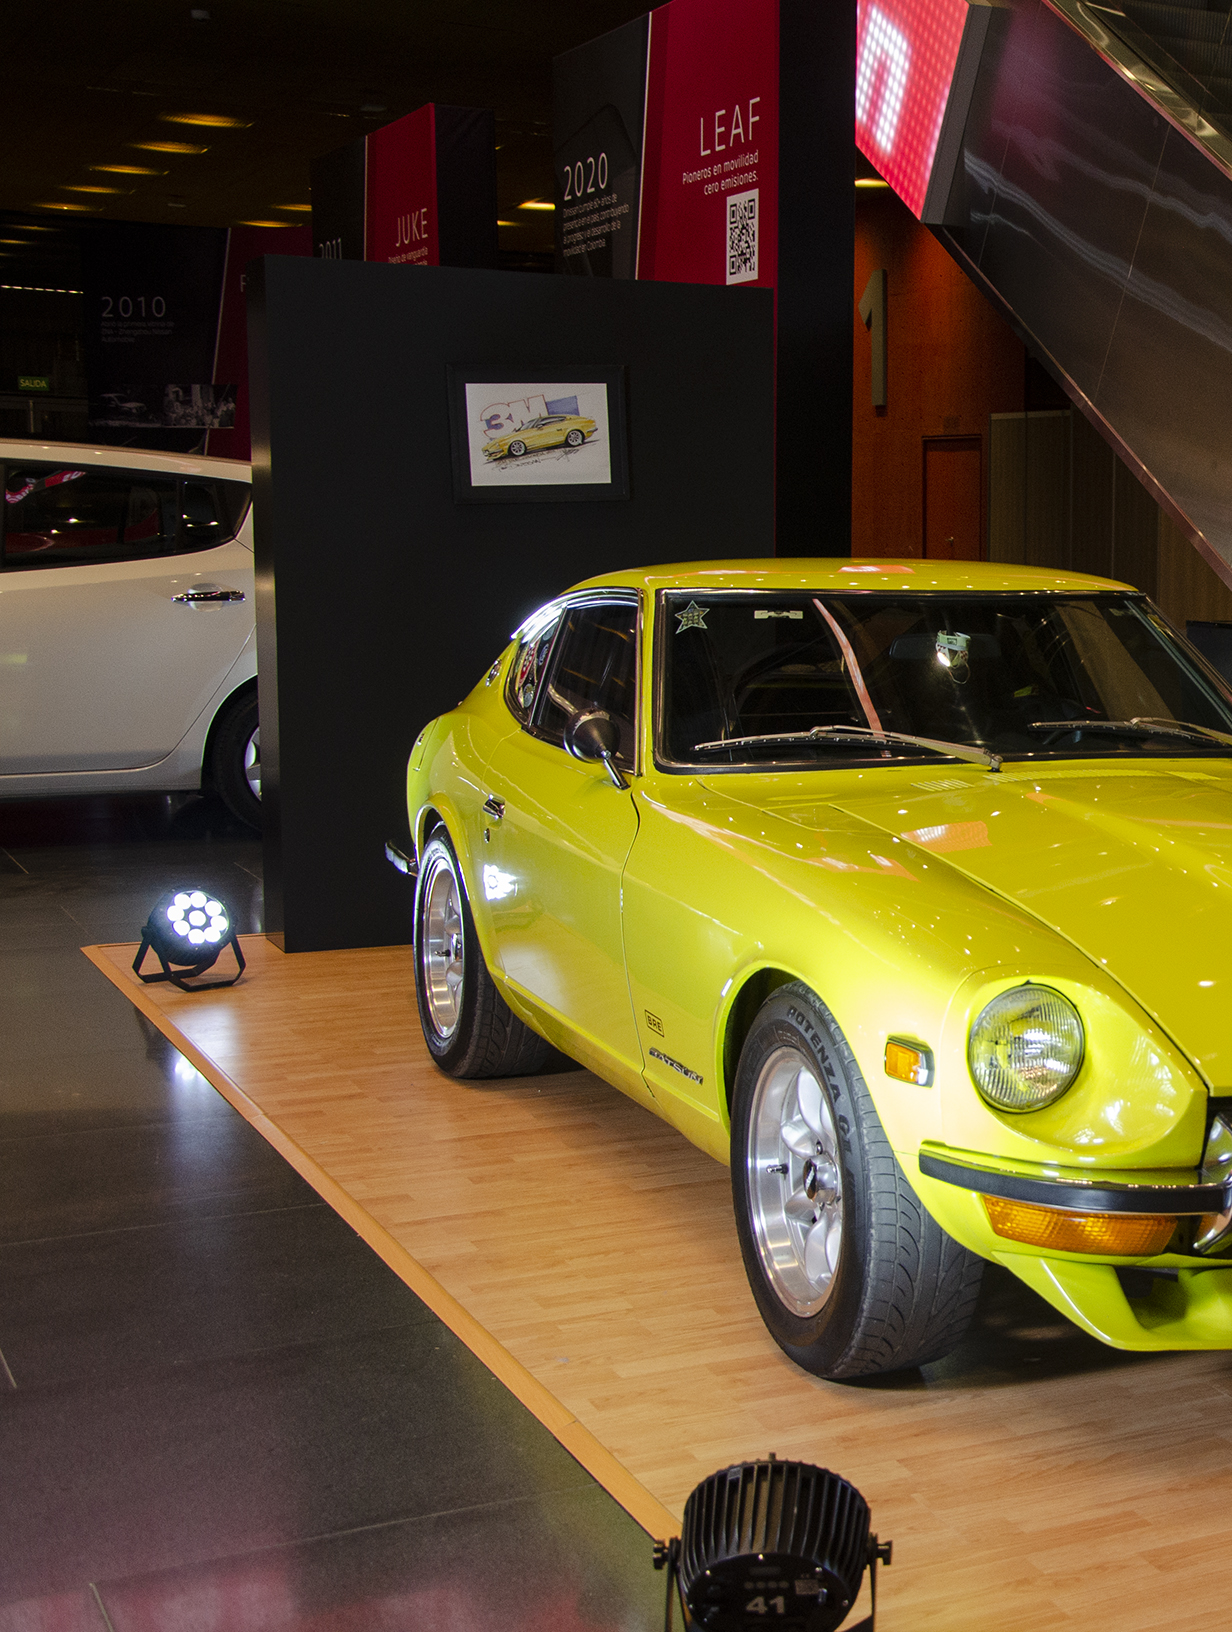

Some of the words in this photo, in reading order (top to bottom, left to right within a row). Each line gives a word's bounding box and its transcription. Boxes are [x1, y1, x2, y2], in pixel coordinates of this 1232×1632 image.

[701, 97, 760, 156] LEAF
[564, 152, 608, 201] 2020
[682, 167, 711, 185] Pioneros
[713, 163, 722, 176] en
[723, 149, 759, 172] movilidad
[704, 181, 719, 195] cero
[721, 170, 758, 190] emisiones.
[395, 208, 428, 247] JUKE
[101, 296, 166, 317] 2010
[19, 378, 47, 388] SALIDA
[787, 1004, 841, 1103] POTENZA
[745, 1596, 785, 1615] 41
